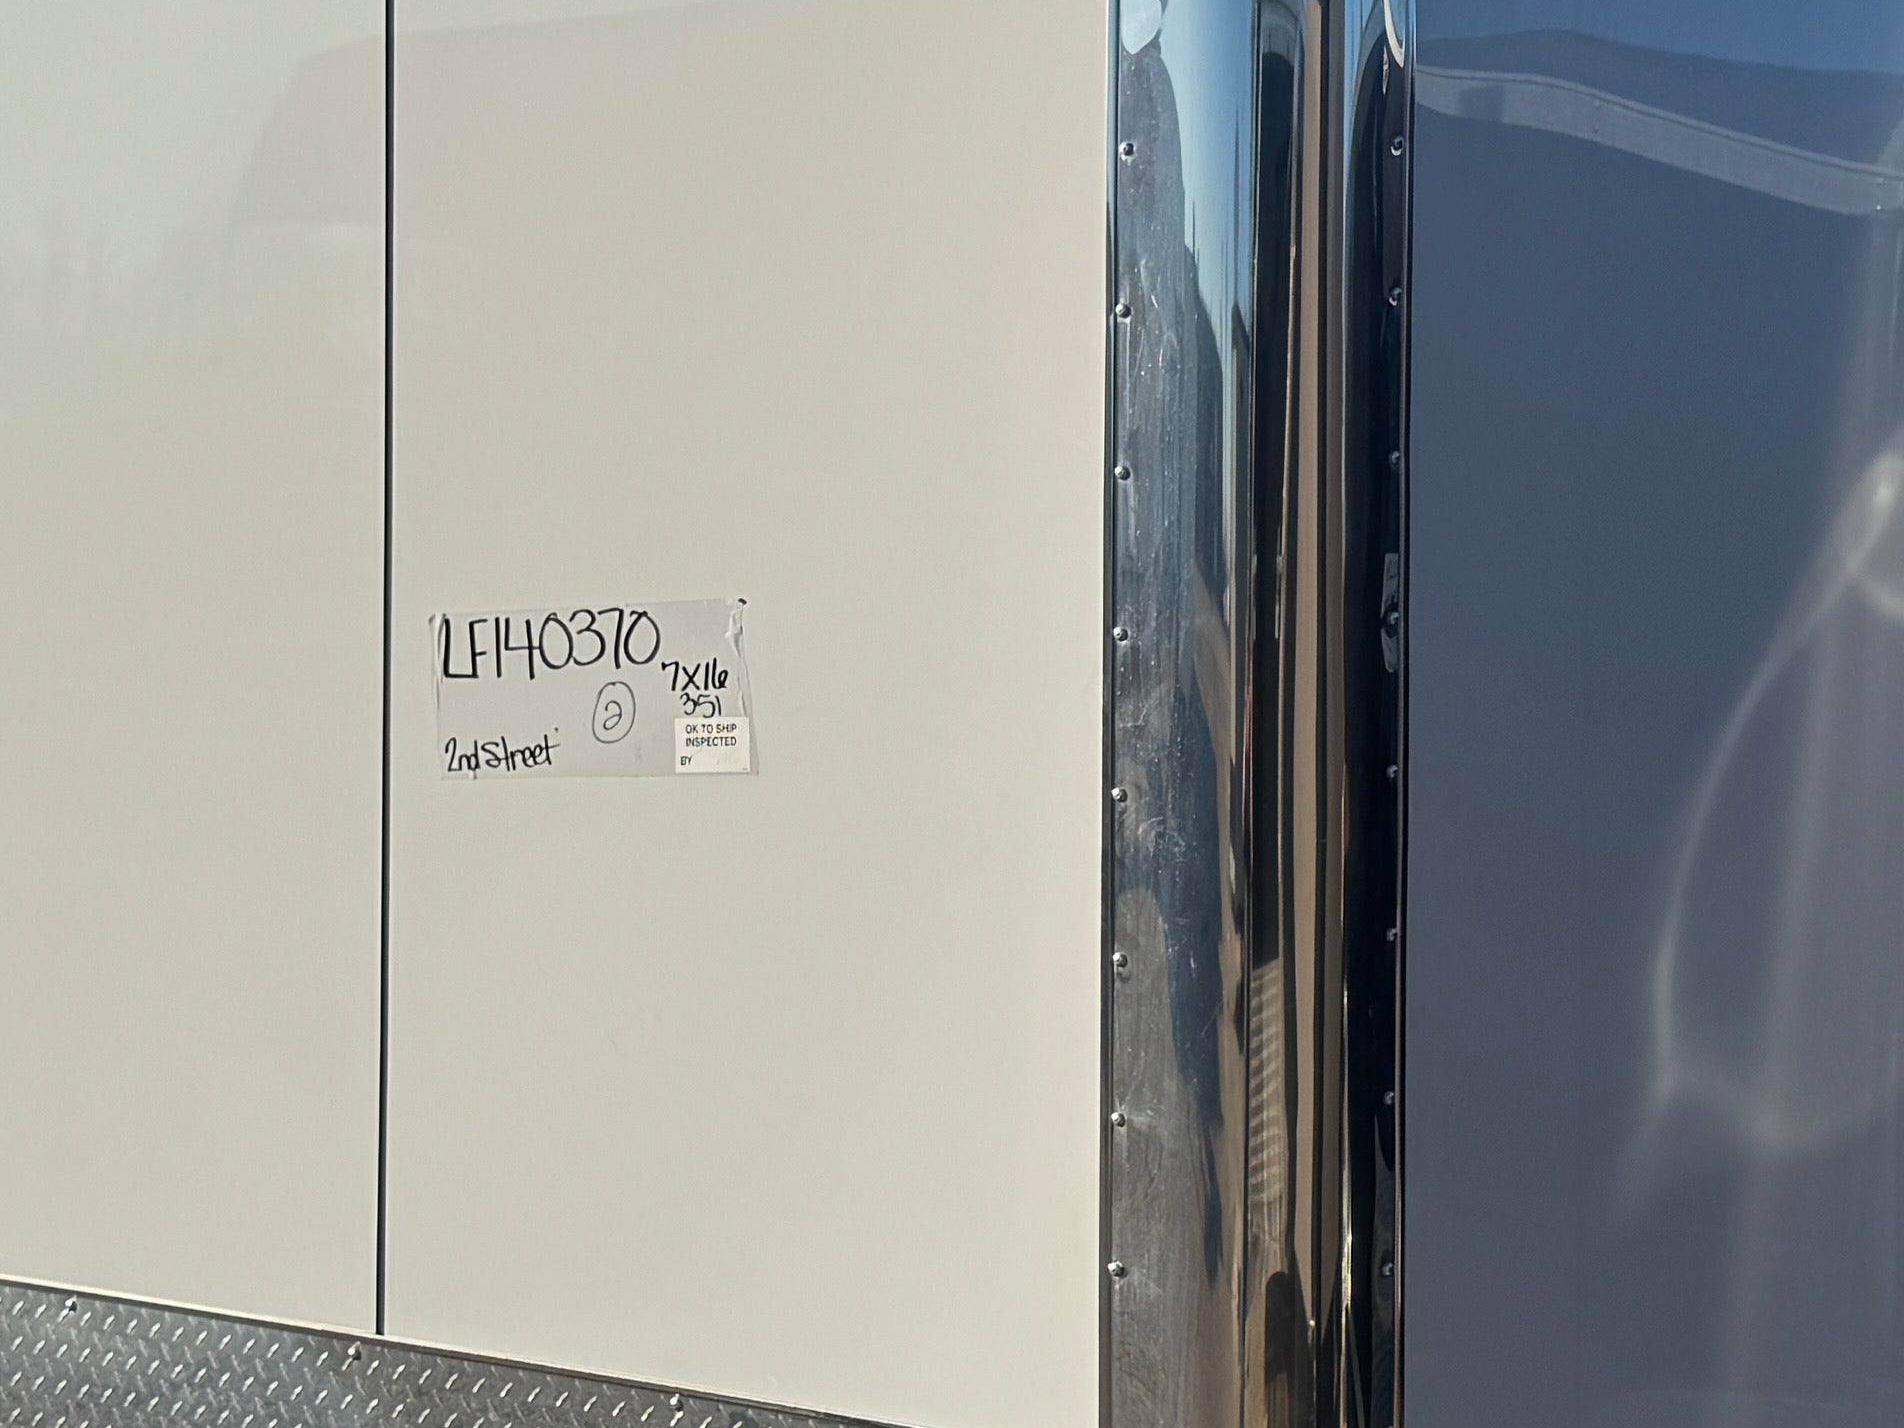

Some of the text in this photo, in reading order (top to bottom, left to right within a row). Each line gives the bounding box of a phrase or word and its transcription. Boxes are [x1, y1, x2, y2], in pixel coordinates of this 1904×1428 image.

[442, 608, 660, 680] LF140370
[685, 724, 737, 734] OK TO SHIP
[685, 736, 737, 747] INSPECTED
[680, 755, 693, 766] BY
